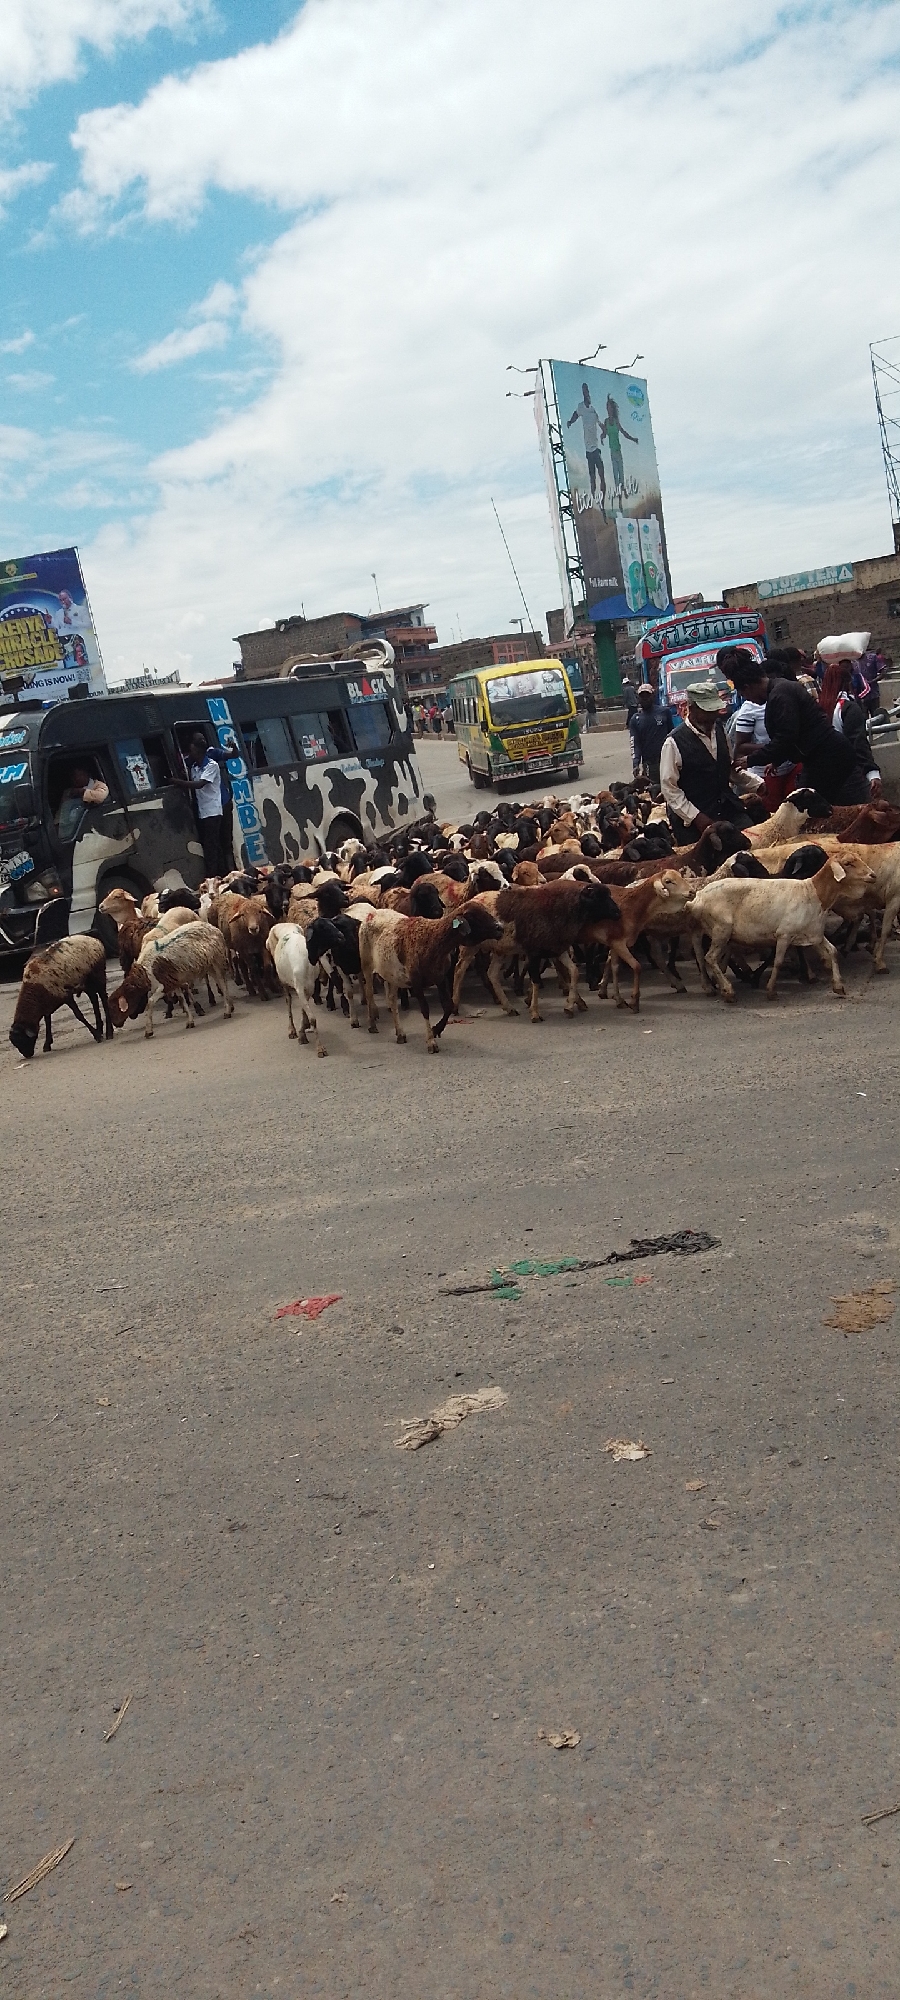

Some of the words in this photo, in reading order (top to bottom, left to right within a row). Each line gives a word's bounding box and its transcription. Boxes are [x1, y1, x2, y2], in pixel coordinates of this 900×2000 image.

[772, 576, 800, 590] TOP
[808, 566, 838, 583] TEN
[806, 577, 840, 590] SCHOOL
[54, 674, 76, 685] NOW!
